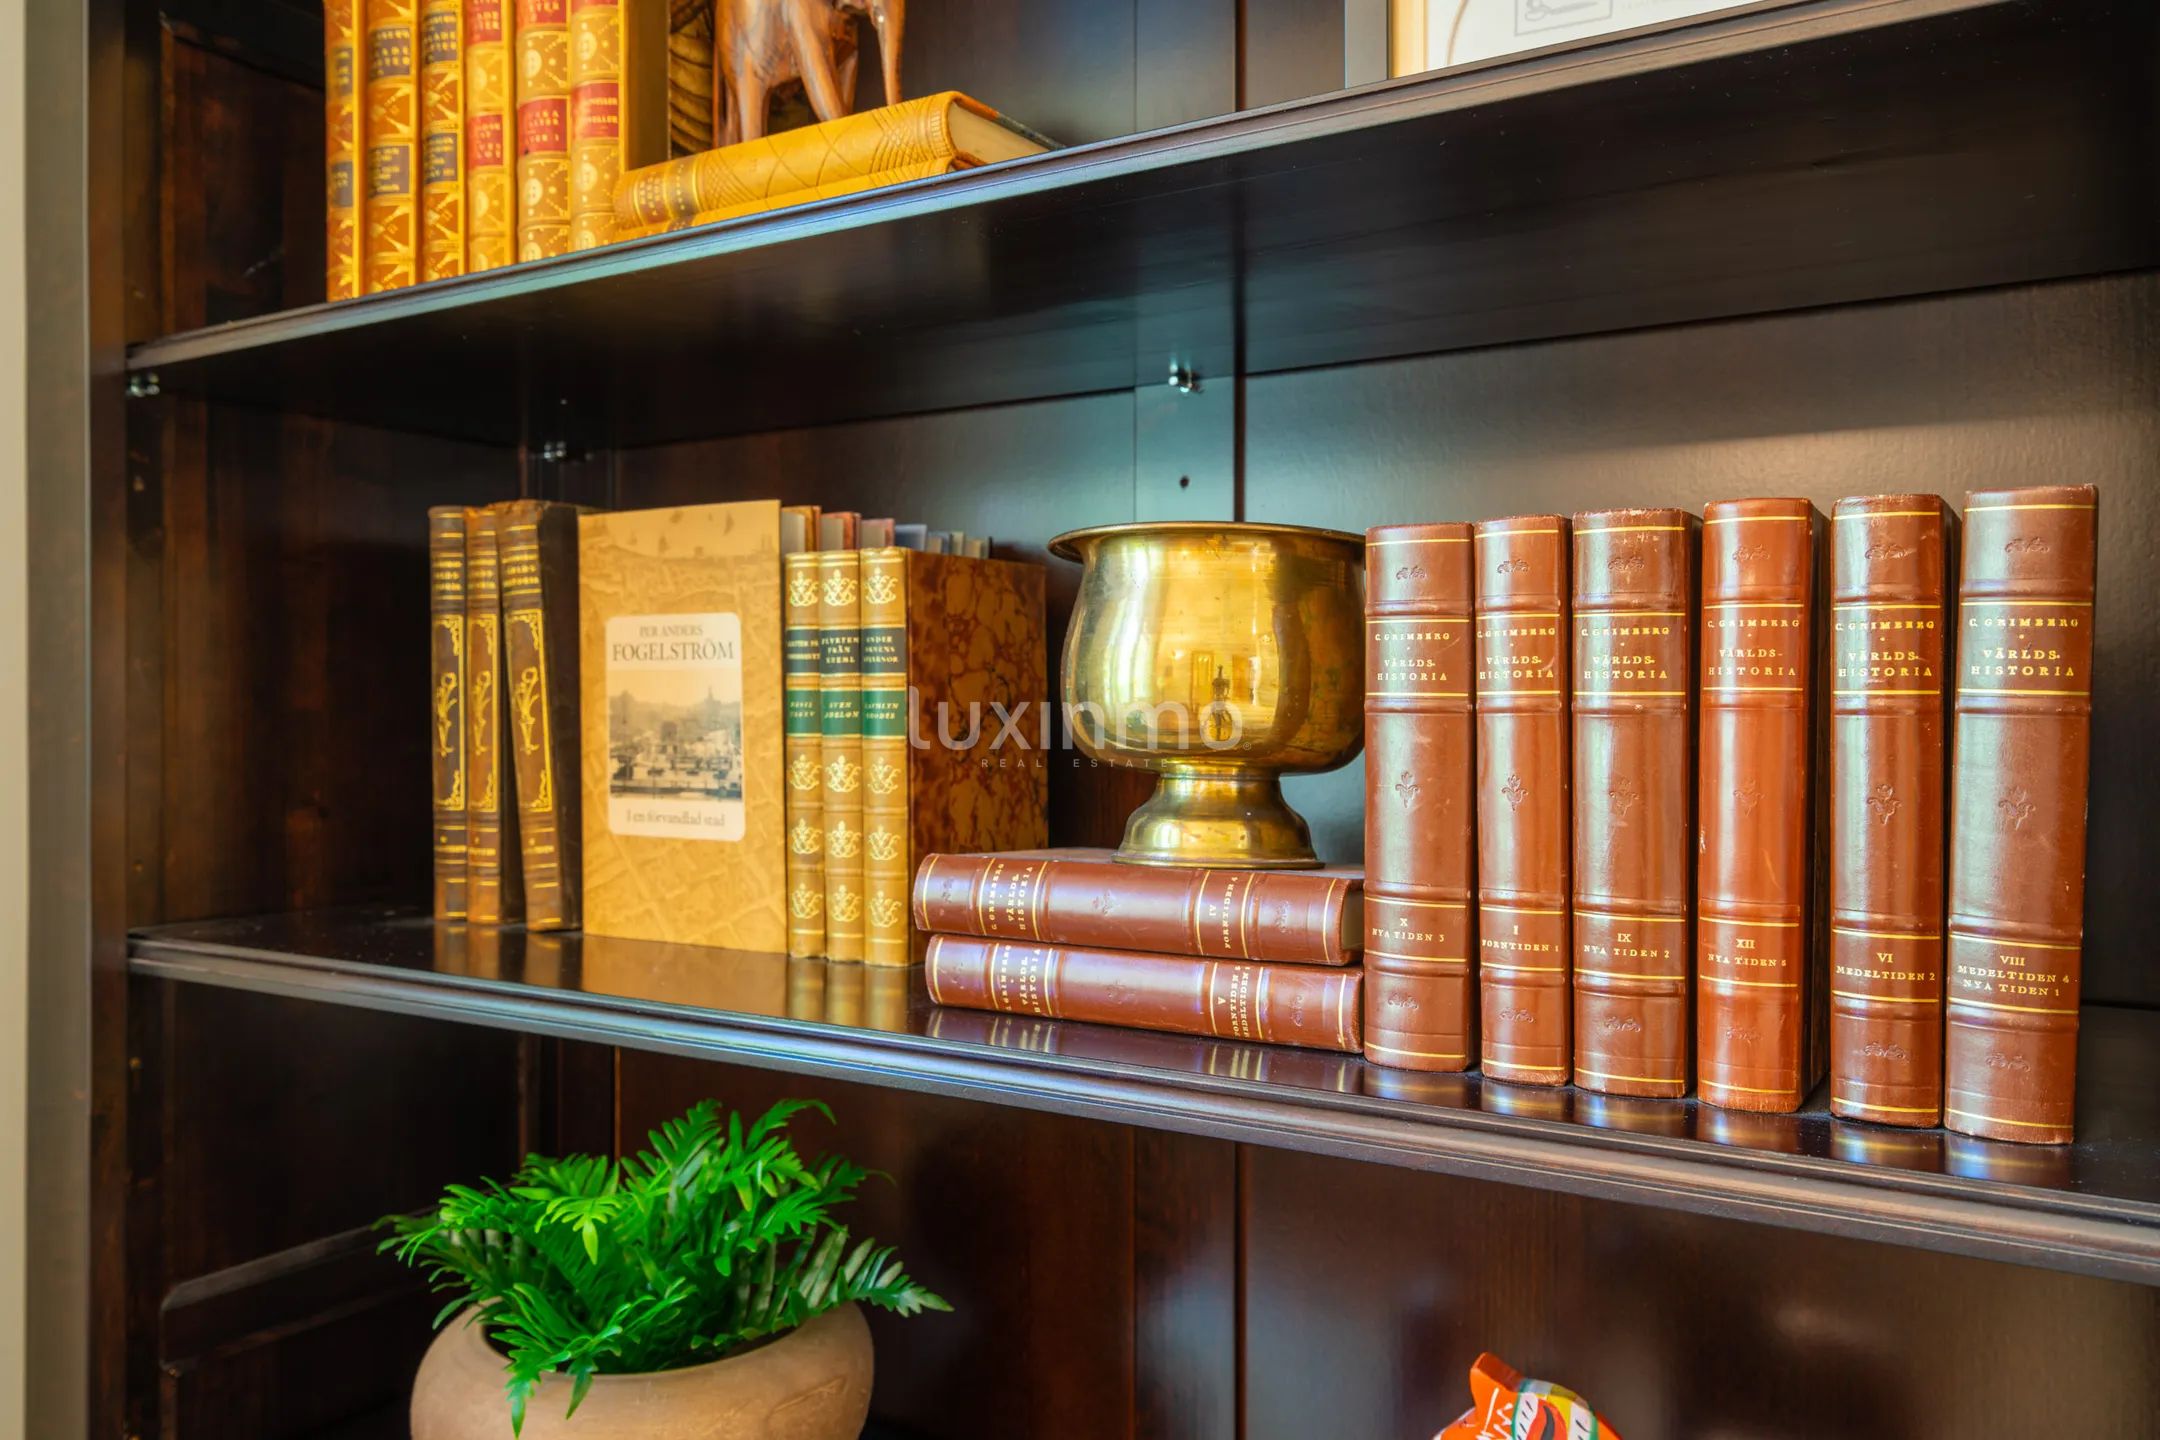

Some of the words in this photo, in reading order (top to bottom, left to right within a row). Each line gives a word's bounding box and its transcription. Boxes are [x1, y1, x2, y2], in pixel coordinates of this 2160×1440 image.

[1718, 619, 1800, 628] GRIMBERG
[1847, 620, 1935, 631] GRIMBERG
[1984, 618, 2079, 627] GRIMBERG
[661, 624, 704, 637] ANDERS
[1384, 632, 1450, 641] GRIMBERG
[1485, 627, 1556, 638] GRIMBERG
[1591, 627, 1670, 636] GRIMBERG
[612, 638, 734, 661] FOGELSTRÖM
[1377, 672, 1447, 681] HISTORIA
[1479, 669, 1554, 680] HISTORIA
[1583, 669, 1668, 680] HISTORIA
[1708, 666, 1796, 676] HISTORIA
[1838, 666, 1932, 677] HISTORIA
[1970, 665, 2074, 677] HISTORIA
[1018, 866, 1033, 930] HISTORIA
[1208, 904, 1217, 917] IV
[1399, 917, 1408, 927] X
[1372, 928, 1390, 938] NYA
[1393, 931, 1433, 942] TIDEN
[1513, 924, 1519, 936] I
[1617, 932, 1632, 943] IX
[1481, 939, 1549, 952] FORNTIDEN
[1735, 938, 1756, 950] XII
[1583, 944, 1607, 956] NYA
[1613, 947, 1658, 958] TIDEN
[1664, 950, 1671, 959] 2
[1707, 953, 1730, 965] NYA
[1734, 956, 1777, 967] TIDEN
[1876, 952, 1894, 964] VI
[2000, 955, 2026, 967] VIII
[1836, 965, 1925, 981] MEDELTIDEN
[1929, 972, 1936, 981] 2
[1957, 964, 2057, 983] MEDELTIDEN
[1963, 979, 1993, 991] NYA
[1998, 983, 2049, 996] TIDEN
[1217, 996, 1227, 1005] V
